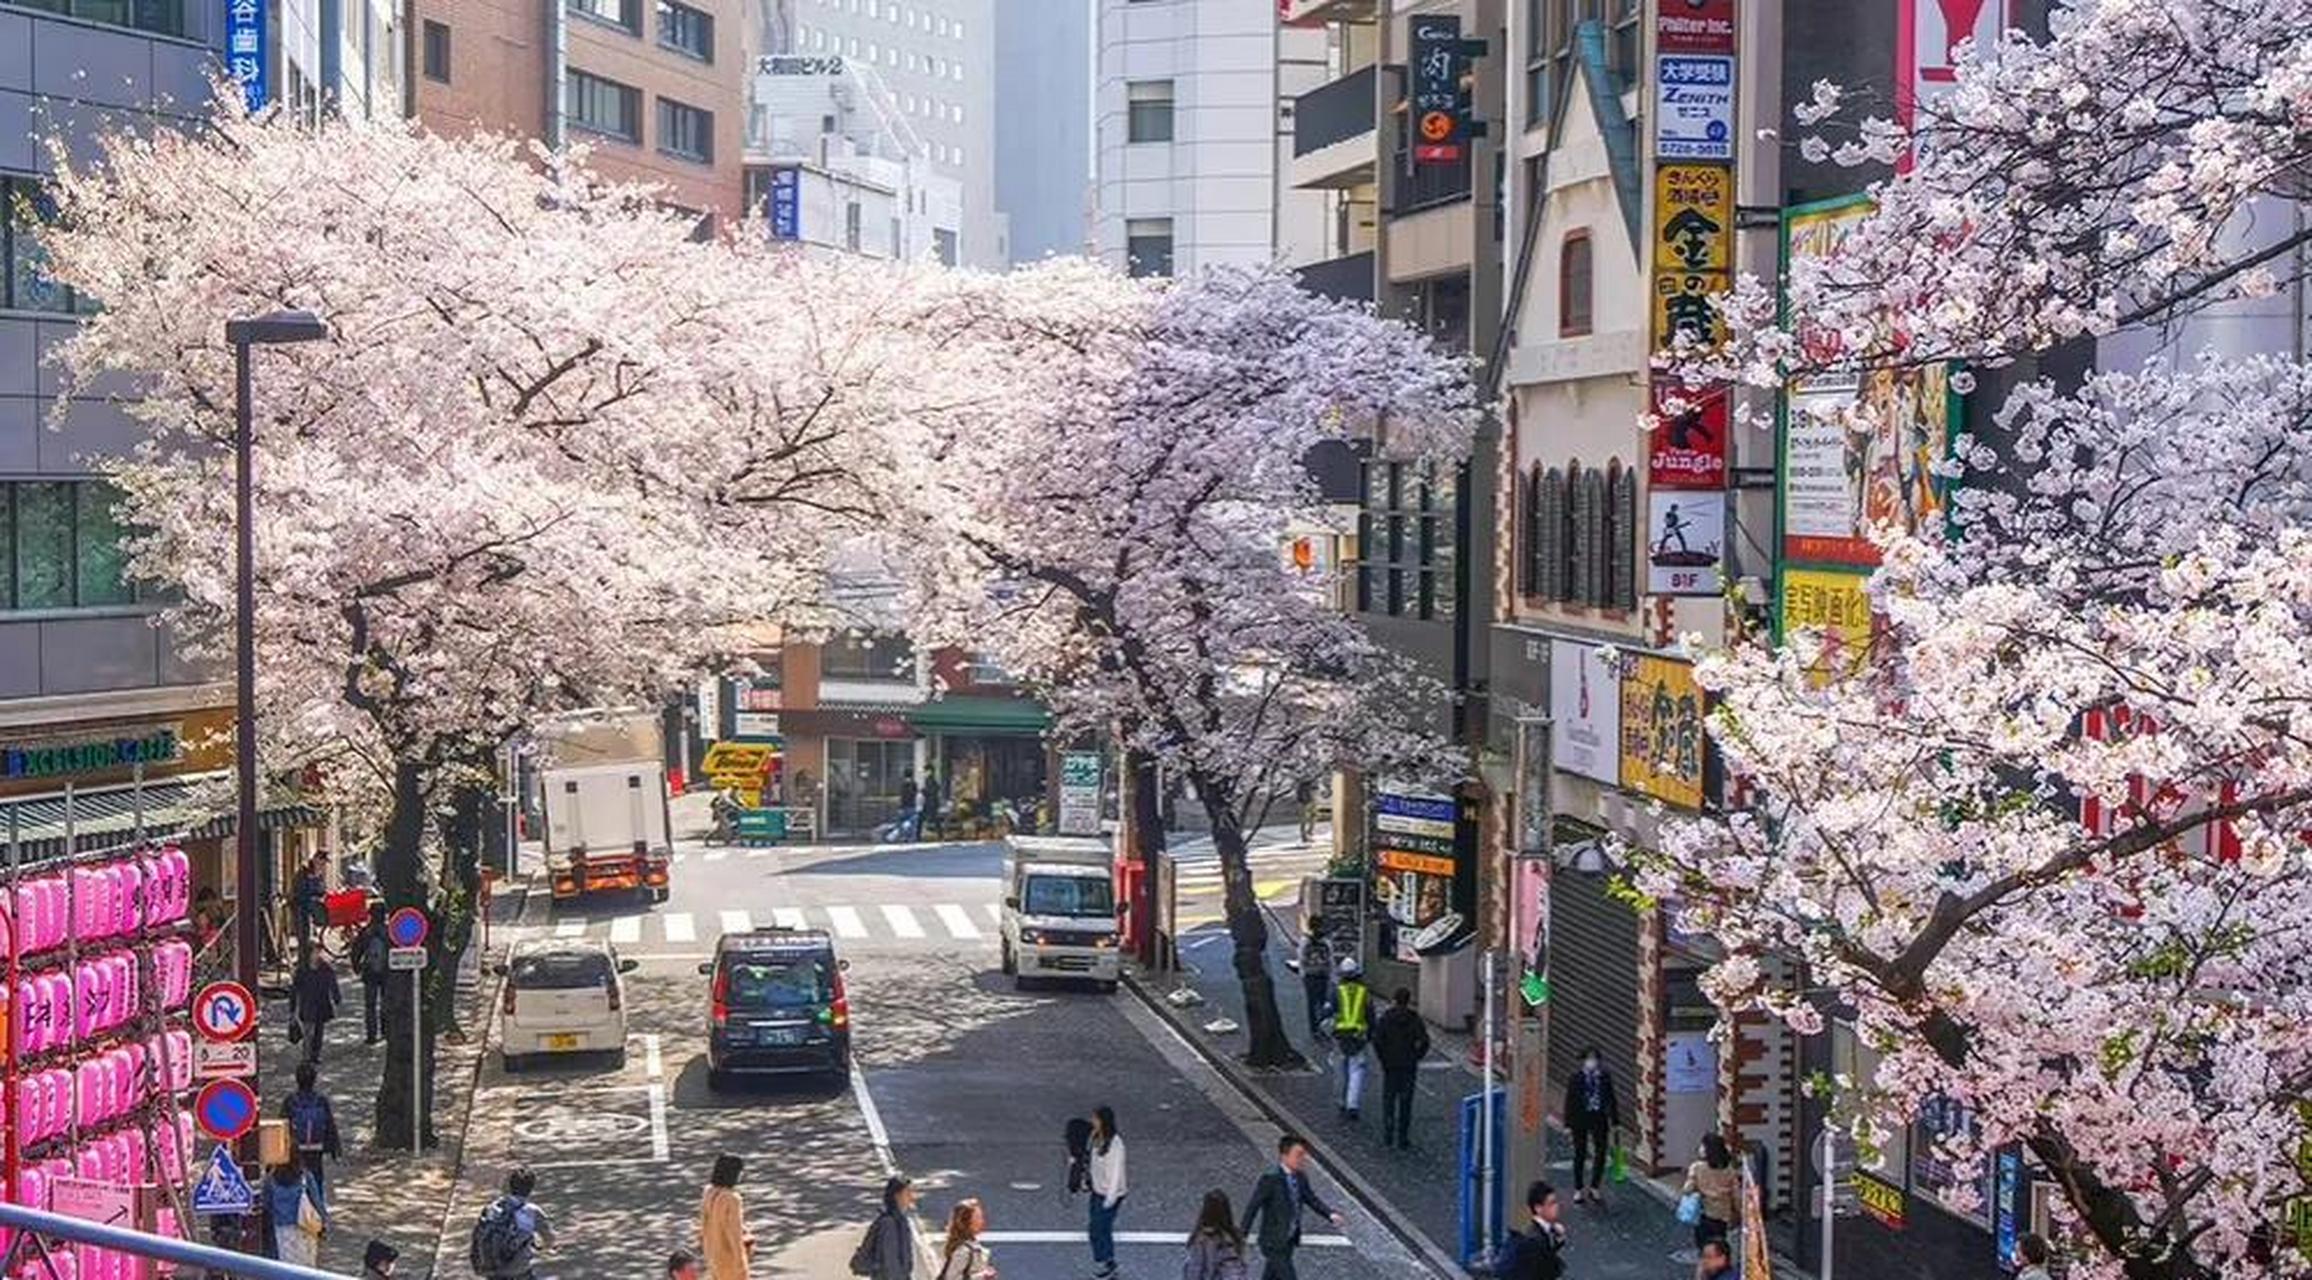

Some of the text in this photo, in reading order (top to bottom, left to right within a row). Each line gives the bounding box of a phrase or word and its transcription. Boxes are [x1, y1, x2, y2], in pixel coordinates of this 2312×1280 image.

[1662, 61, 1728, 82] 大学受験
[1651, 452, 1723, 473] Jungle
[233, 1046, 250, 1060] 20
